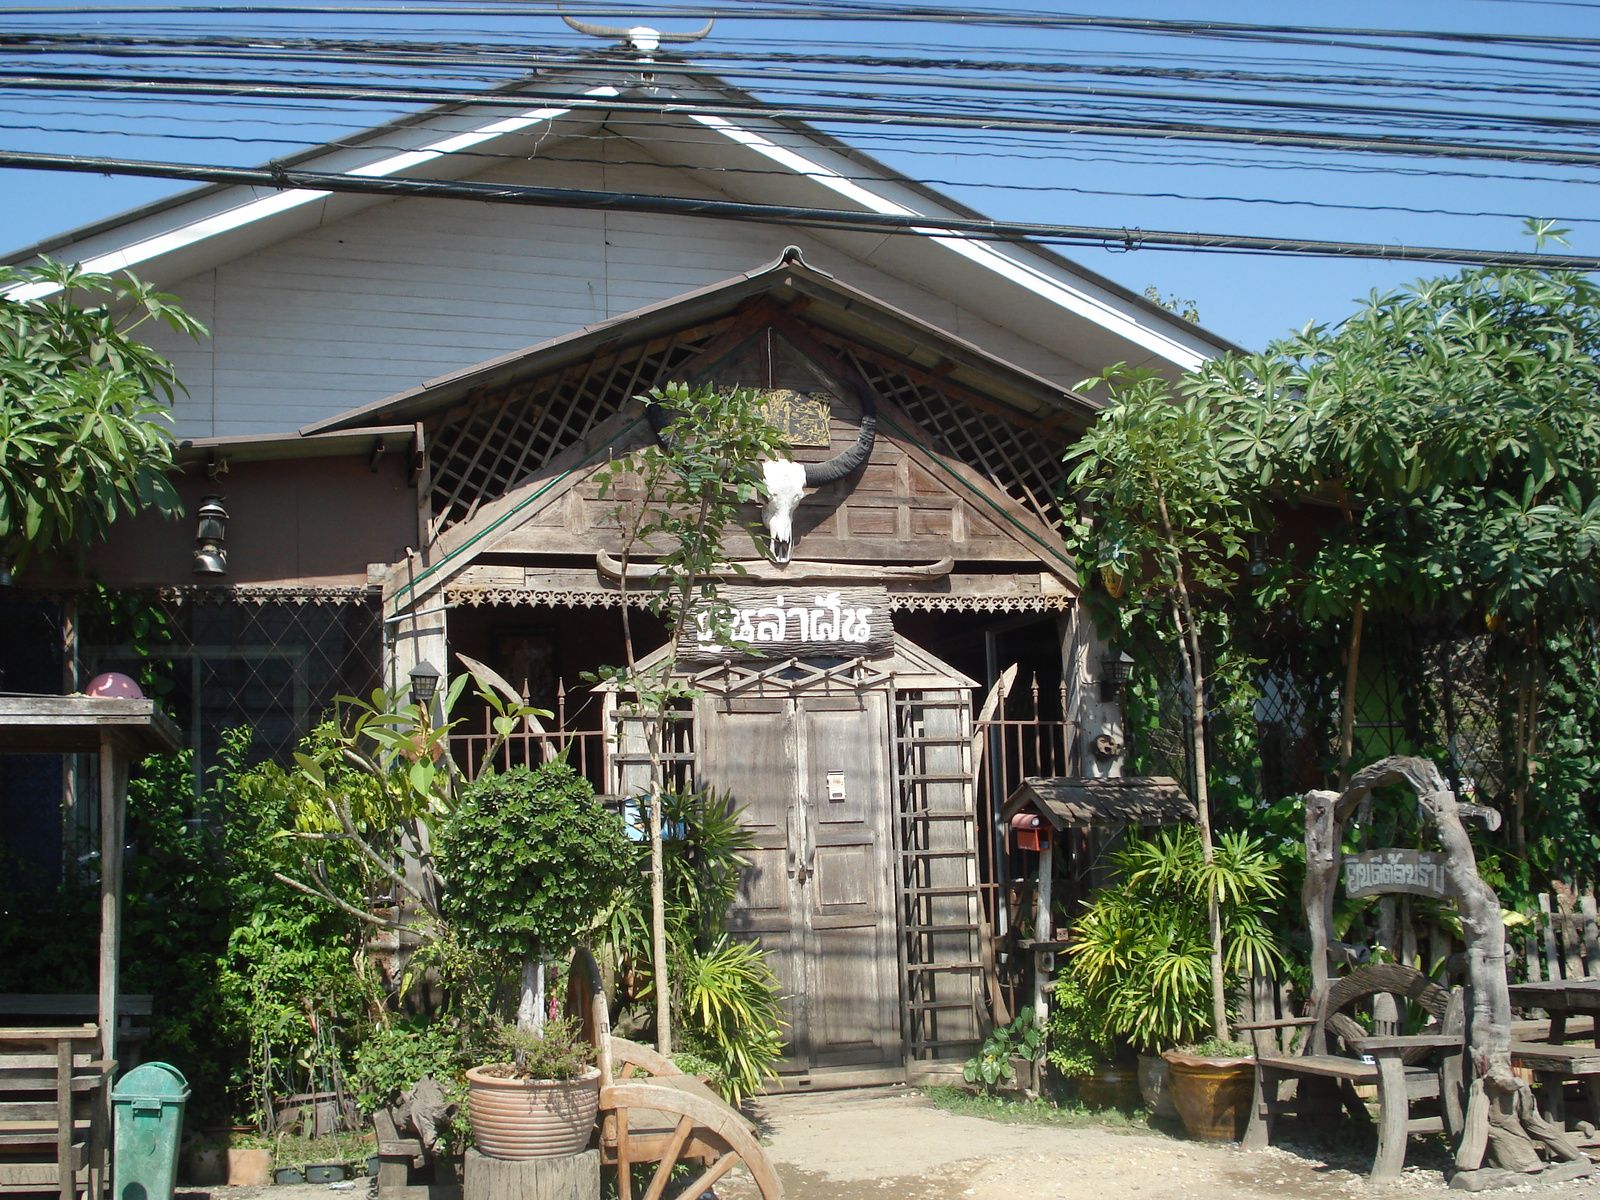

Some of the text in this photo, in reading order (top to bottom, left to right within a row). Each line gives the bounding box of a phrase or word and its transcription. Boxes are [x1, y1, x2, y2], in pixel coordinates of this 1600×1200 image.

[1345, 853, 1445, 894] ยินดีต้อนรับ
